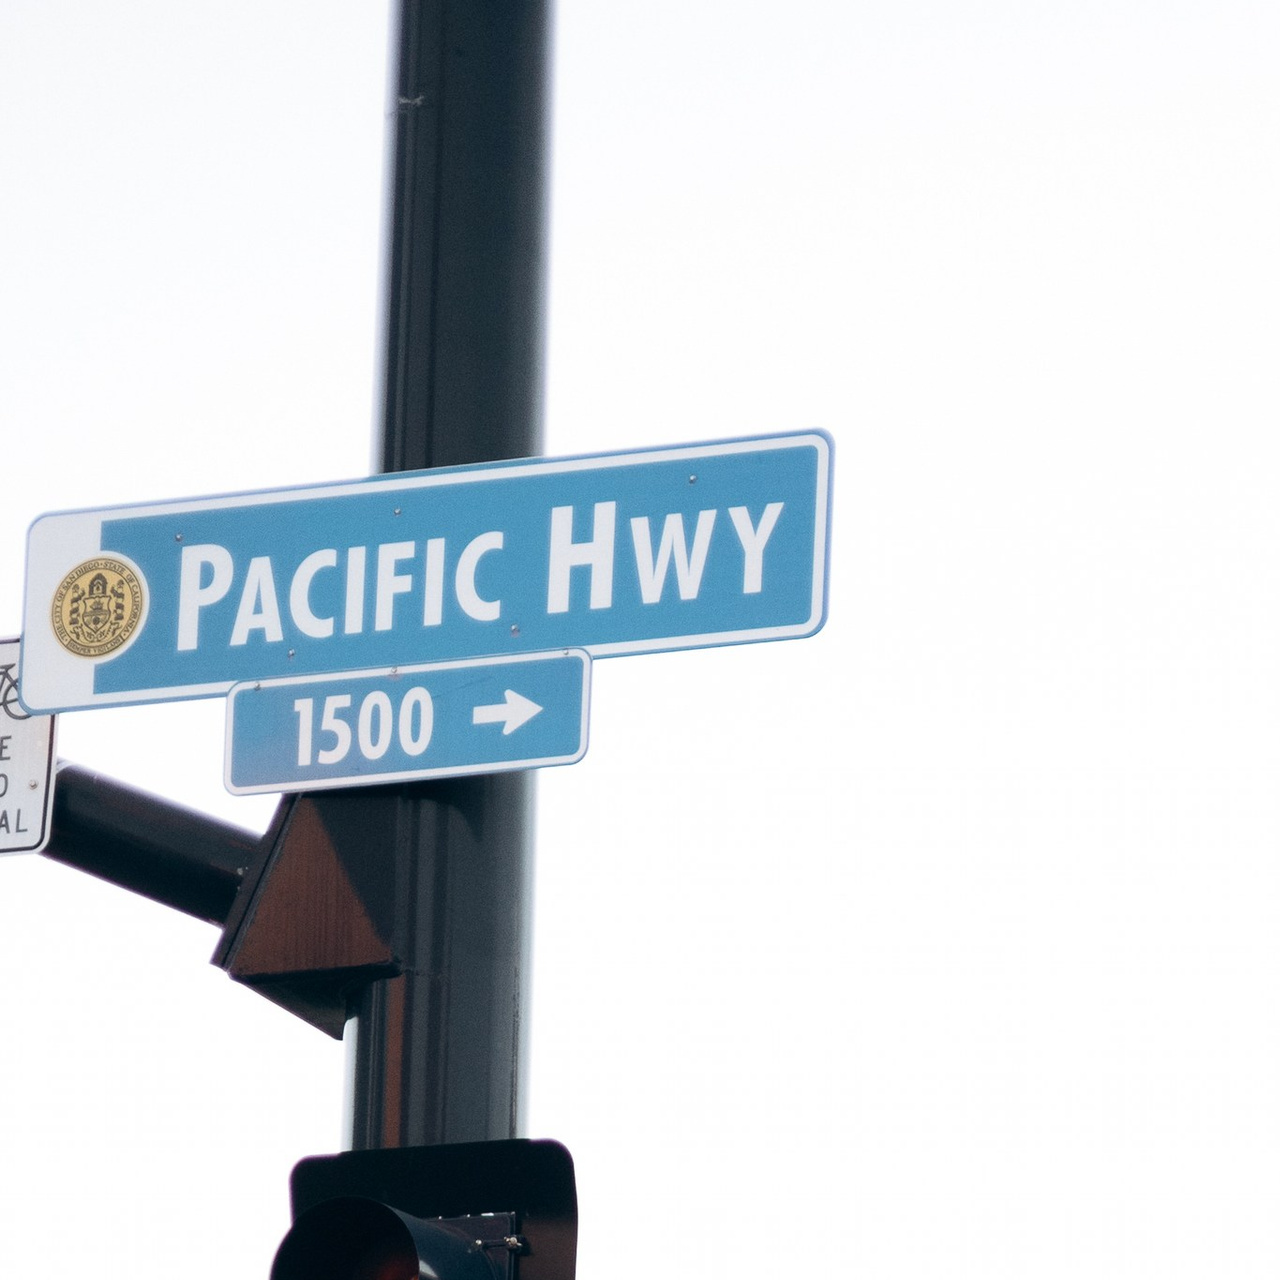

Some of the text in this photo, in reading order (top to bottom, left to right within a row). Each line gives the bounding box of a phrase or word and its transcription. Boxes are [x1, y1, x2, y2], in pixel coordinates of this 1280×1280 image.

[62, 573, 76, 591] SAN
[75, 561, 100, 577] DIEGO
[103, 561, 125, 575] STATE
[126, 573, 136, 584] OF
[176, 501, 786, 652] PACIFIC HWY
[294, 686, 435, 767] 1500
